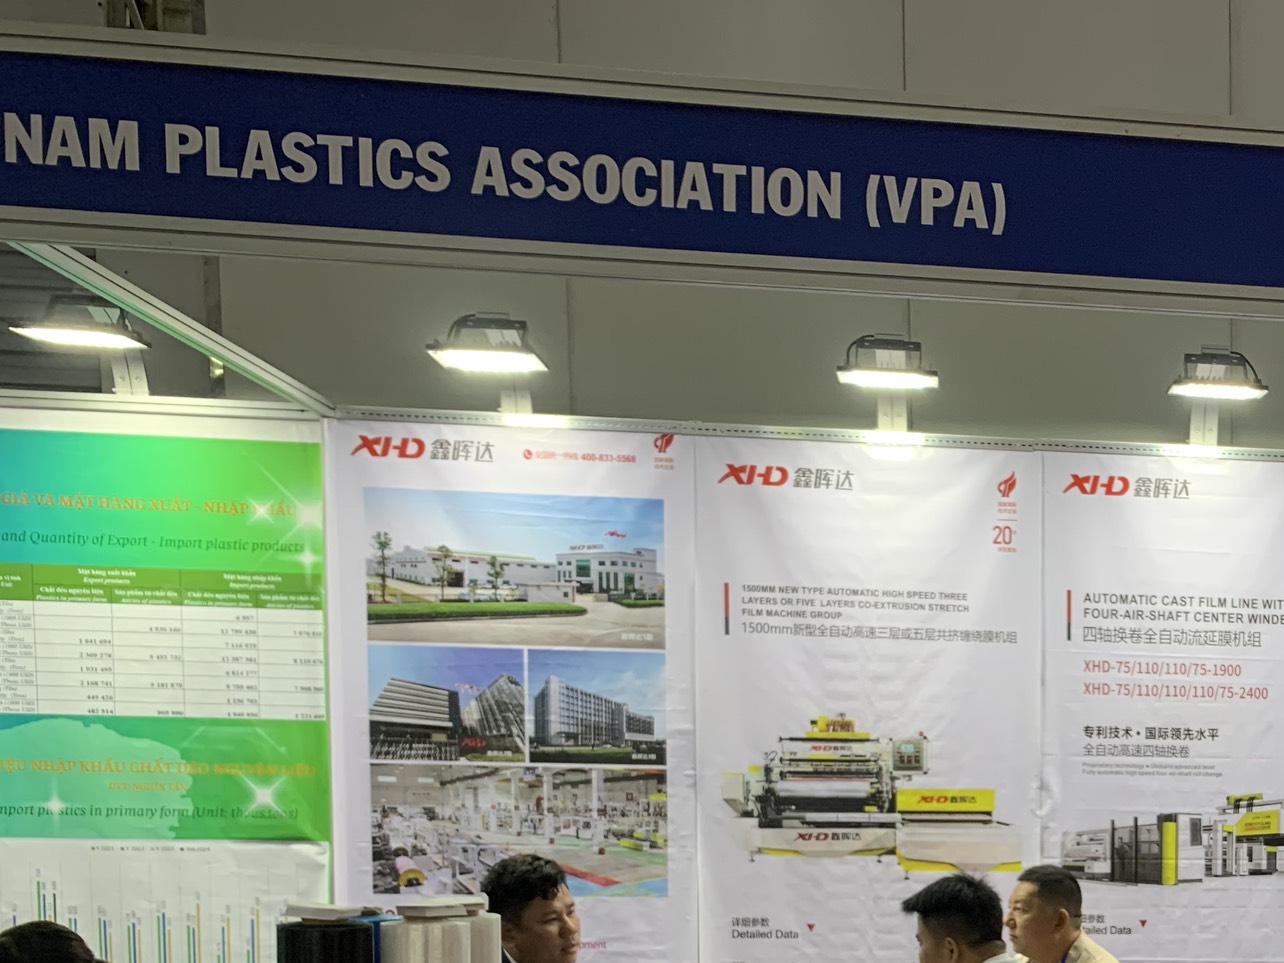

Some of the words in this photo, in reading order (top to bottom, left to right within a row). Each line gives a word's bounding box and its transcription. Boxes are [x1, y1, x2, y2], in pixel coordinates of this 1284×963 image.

[4, 112, 140, 171] NAM
[165, 123, 450, 193] PLASTICS
[471, 147, 842, 220] ASSOCIATION
[866, 175, 1006, 236] (VPA)
[351, 435, 425, 458] XHD
[430, 438, 495, 462] 鑫晖达
[581, 454, 637, 463] 400-833-5568
[717, 464, 789, 486] XHD
[793, 467, 854, 491] 鑫晖达
[1062, 474, 1130, 497] XHD
[1133, 477, 1190, 499] 鑫晖达
[99, 494, 145, 510] HÀNG
[204, 500, 248, 516] NHẬP
[2, 530, 26, 542] and
[30, 531, 89, 547] Quantity
[92, 533, 105, 547] of
[107, 534, 147, 548] Export
[160, 536, 202, 549] Import
[206, 538, 249, 551] plastic
[251, 541, 305, 553] products
[742, 584, 776, 593] 1500MM
[778, 585, 799, 594] NEW
[802, 587, 825, 595] TYPE
[827, 588, 879, 597] AUTOMATIC
[882, 590, 904, 598] HIGH
[906, 591, 936, 599] SPEED
[938, 592, 968, 601] THREE
[1083, 593, 1158, 607] AUTOMATIC
[1161, 595, 1196, 607] CAST
[1198, 596, 1227, 609] FILM
[1231, 597, 1258, 609] LINE
[742, 596, 778, 605] LAYERS
[780, 597, 794, 606] OR
[796, 598, 816, 607] FIVE
[820, 599, 856, 608] LAYERS
[858, 600, 926, 611] CO-EXTRUSION
[928, 603, 969, 613] STRETCH
[742, 608, 763, 617] FILM
[766, 609, 807, 618] MACHINE
[810, 610, 843, 619] GROUP
[1083, 607, 1190, 623] FOUR-AIR-SHAFT
[1193, 611, 1244, 624] CENTER
[1082, 626, 1262, 648] 四轴换卷全自动流延膜机组
[1083, 660, 1242, 677] XHD-75/110/110/75-1900
[1083, 682, 1269, 700] XHD-75/110/110/110/75-2400
[1082, 743, 1190, 759] 全自动高速四轴换卷
[90, 805, 102, 816] in
[106, 805, 156, 819] primary
[160, 806, 189, 818] form
[731, 929, 773, 939] Detailed
[775, 930, 799, 939] Data
[1110, 926, 1132, 935] Data
